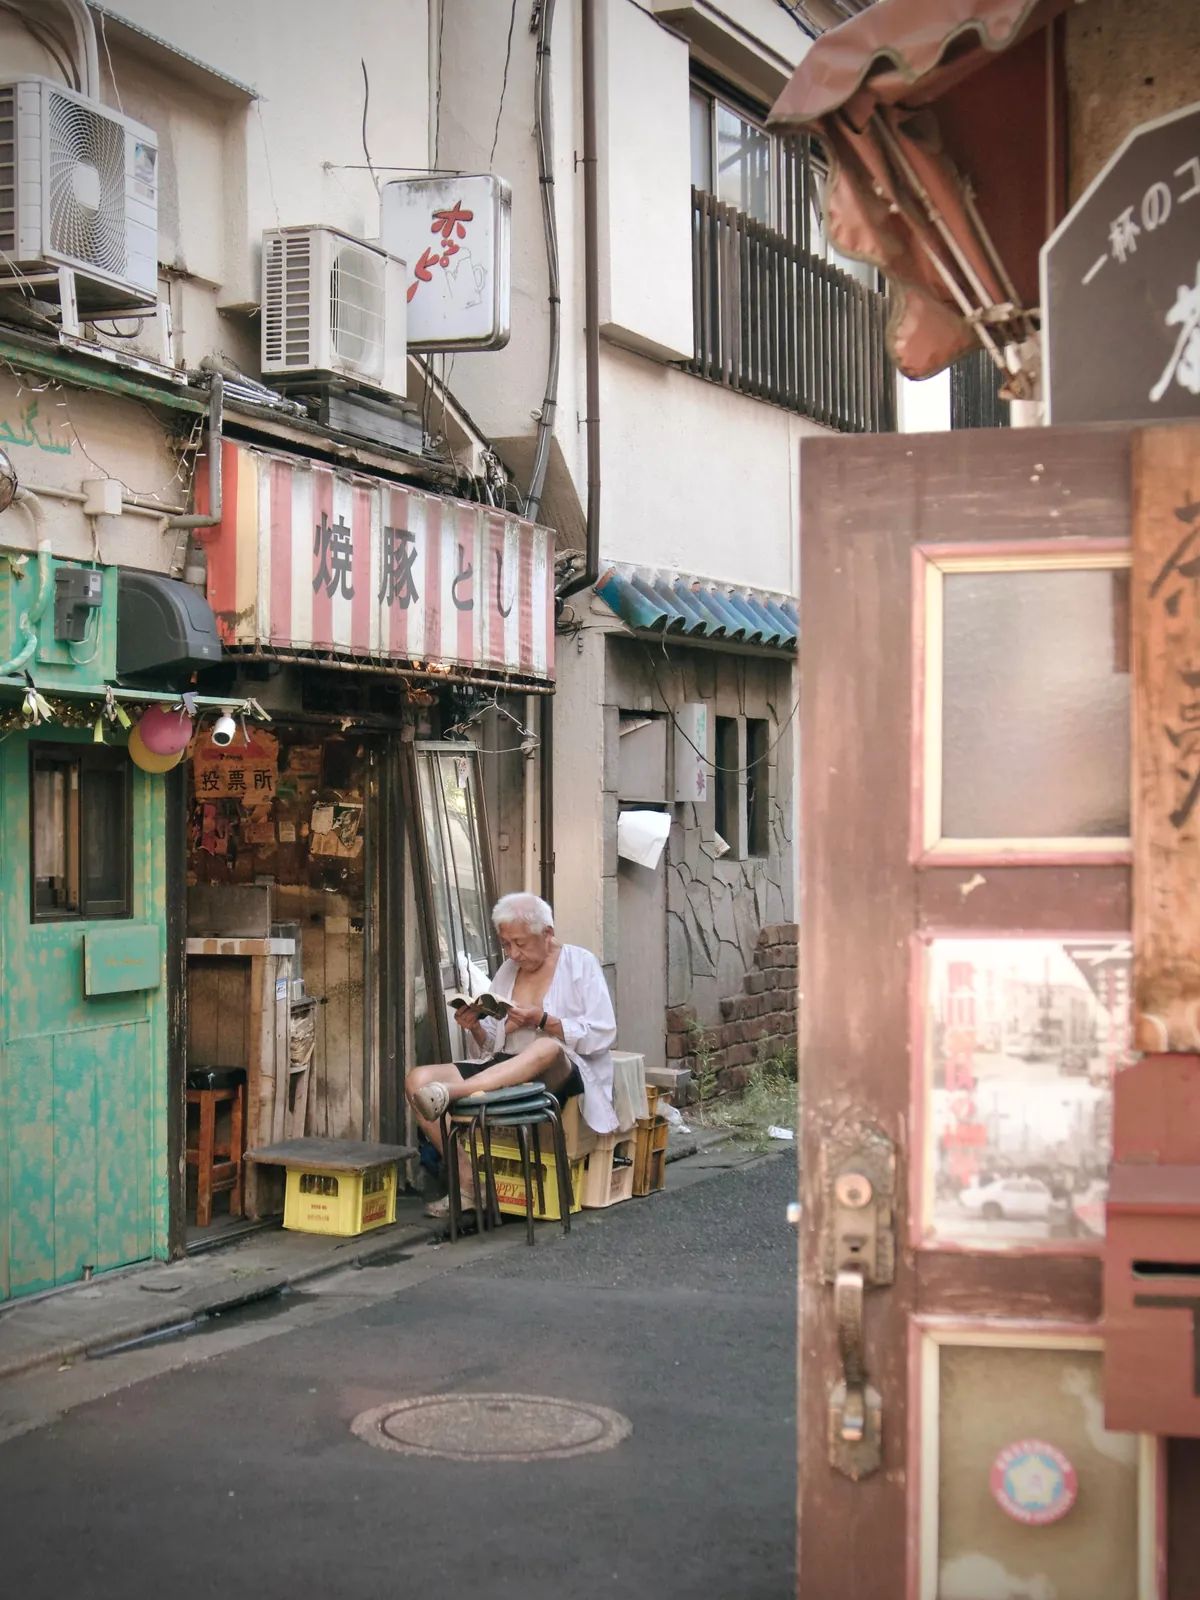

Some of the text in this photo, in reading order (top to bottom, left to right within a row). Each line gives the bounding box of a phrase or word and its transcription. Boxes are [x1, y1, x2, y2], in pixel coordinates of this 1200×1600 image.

[312, 511, 515, 619] 焼豚とし
[202, 769, 272, 792] 投票所
